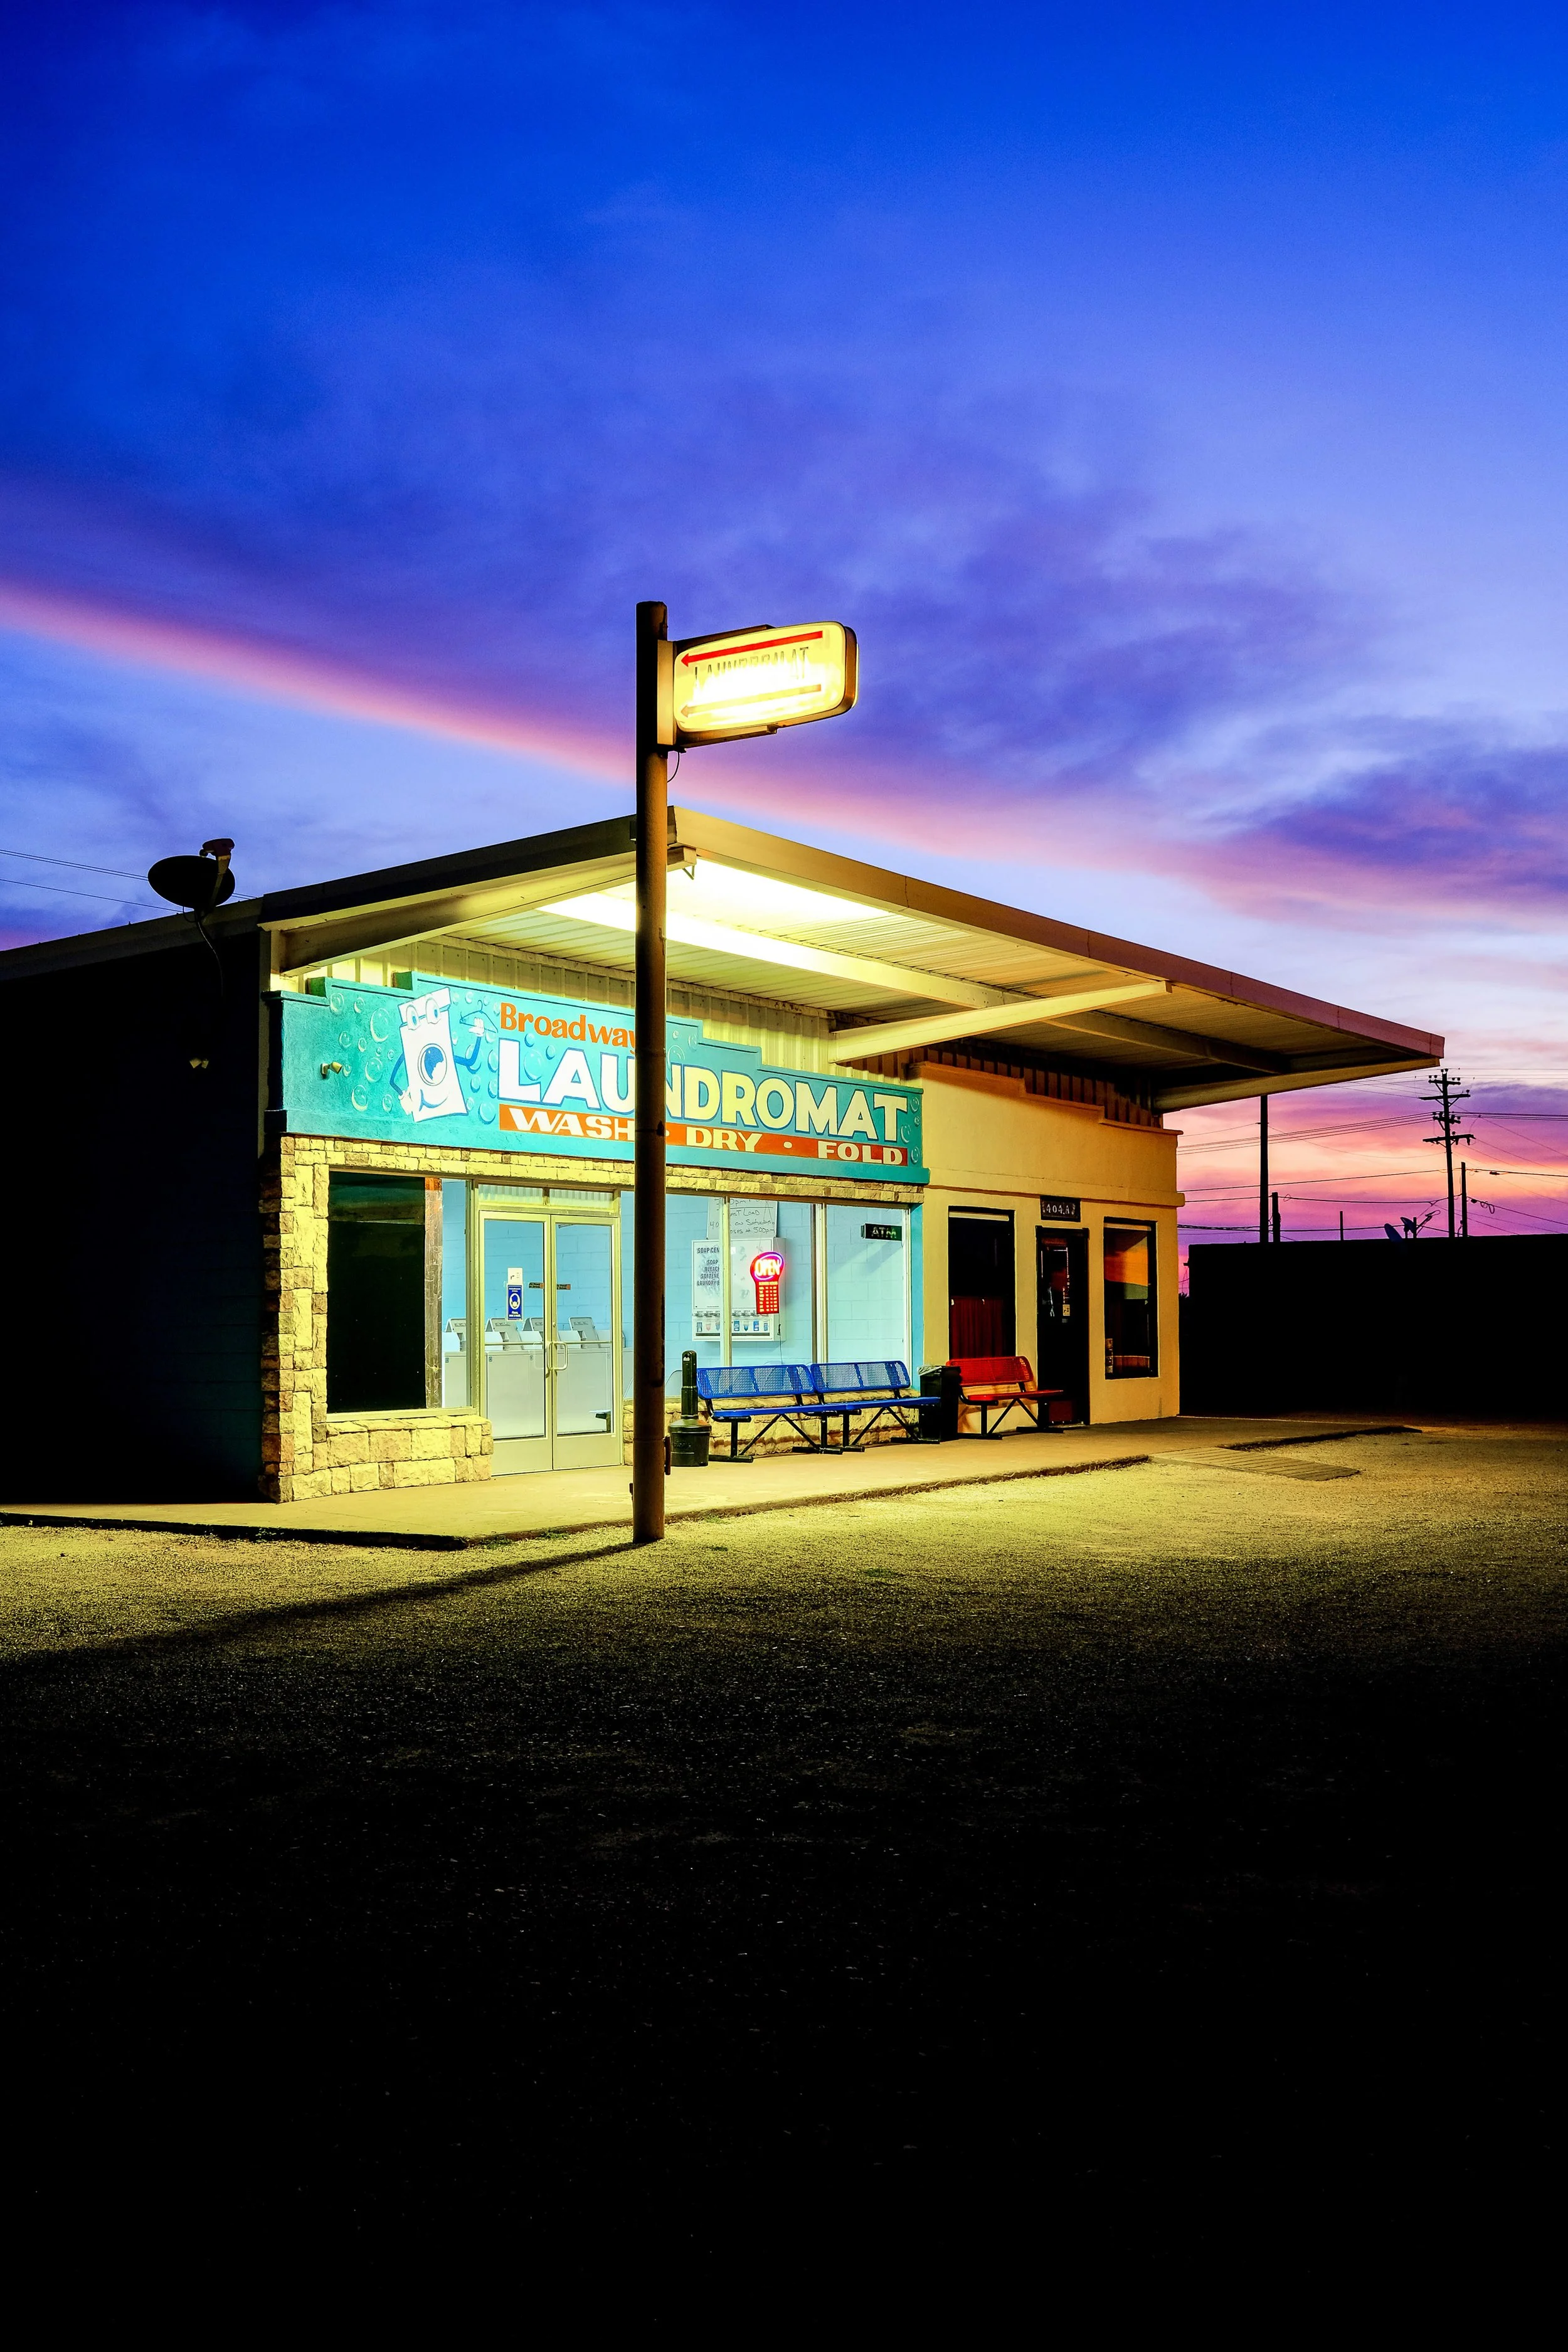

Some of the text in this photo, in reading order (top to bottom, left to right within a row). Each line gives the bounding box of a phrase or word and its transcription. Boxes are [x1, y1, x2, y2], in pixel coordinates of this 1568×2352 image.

[508, 1108, 903, 1166] WASH DRY FOLD
[871, 1227, 897, 1238] ATM
[755, 1259, 780, 1276] OPEN
